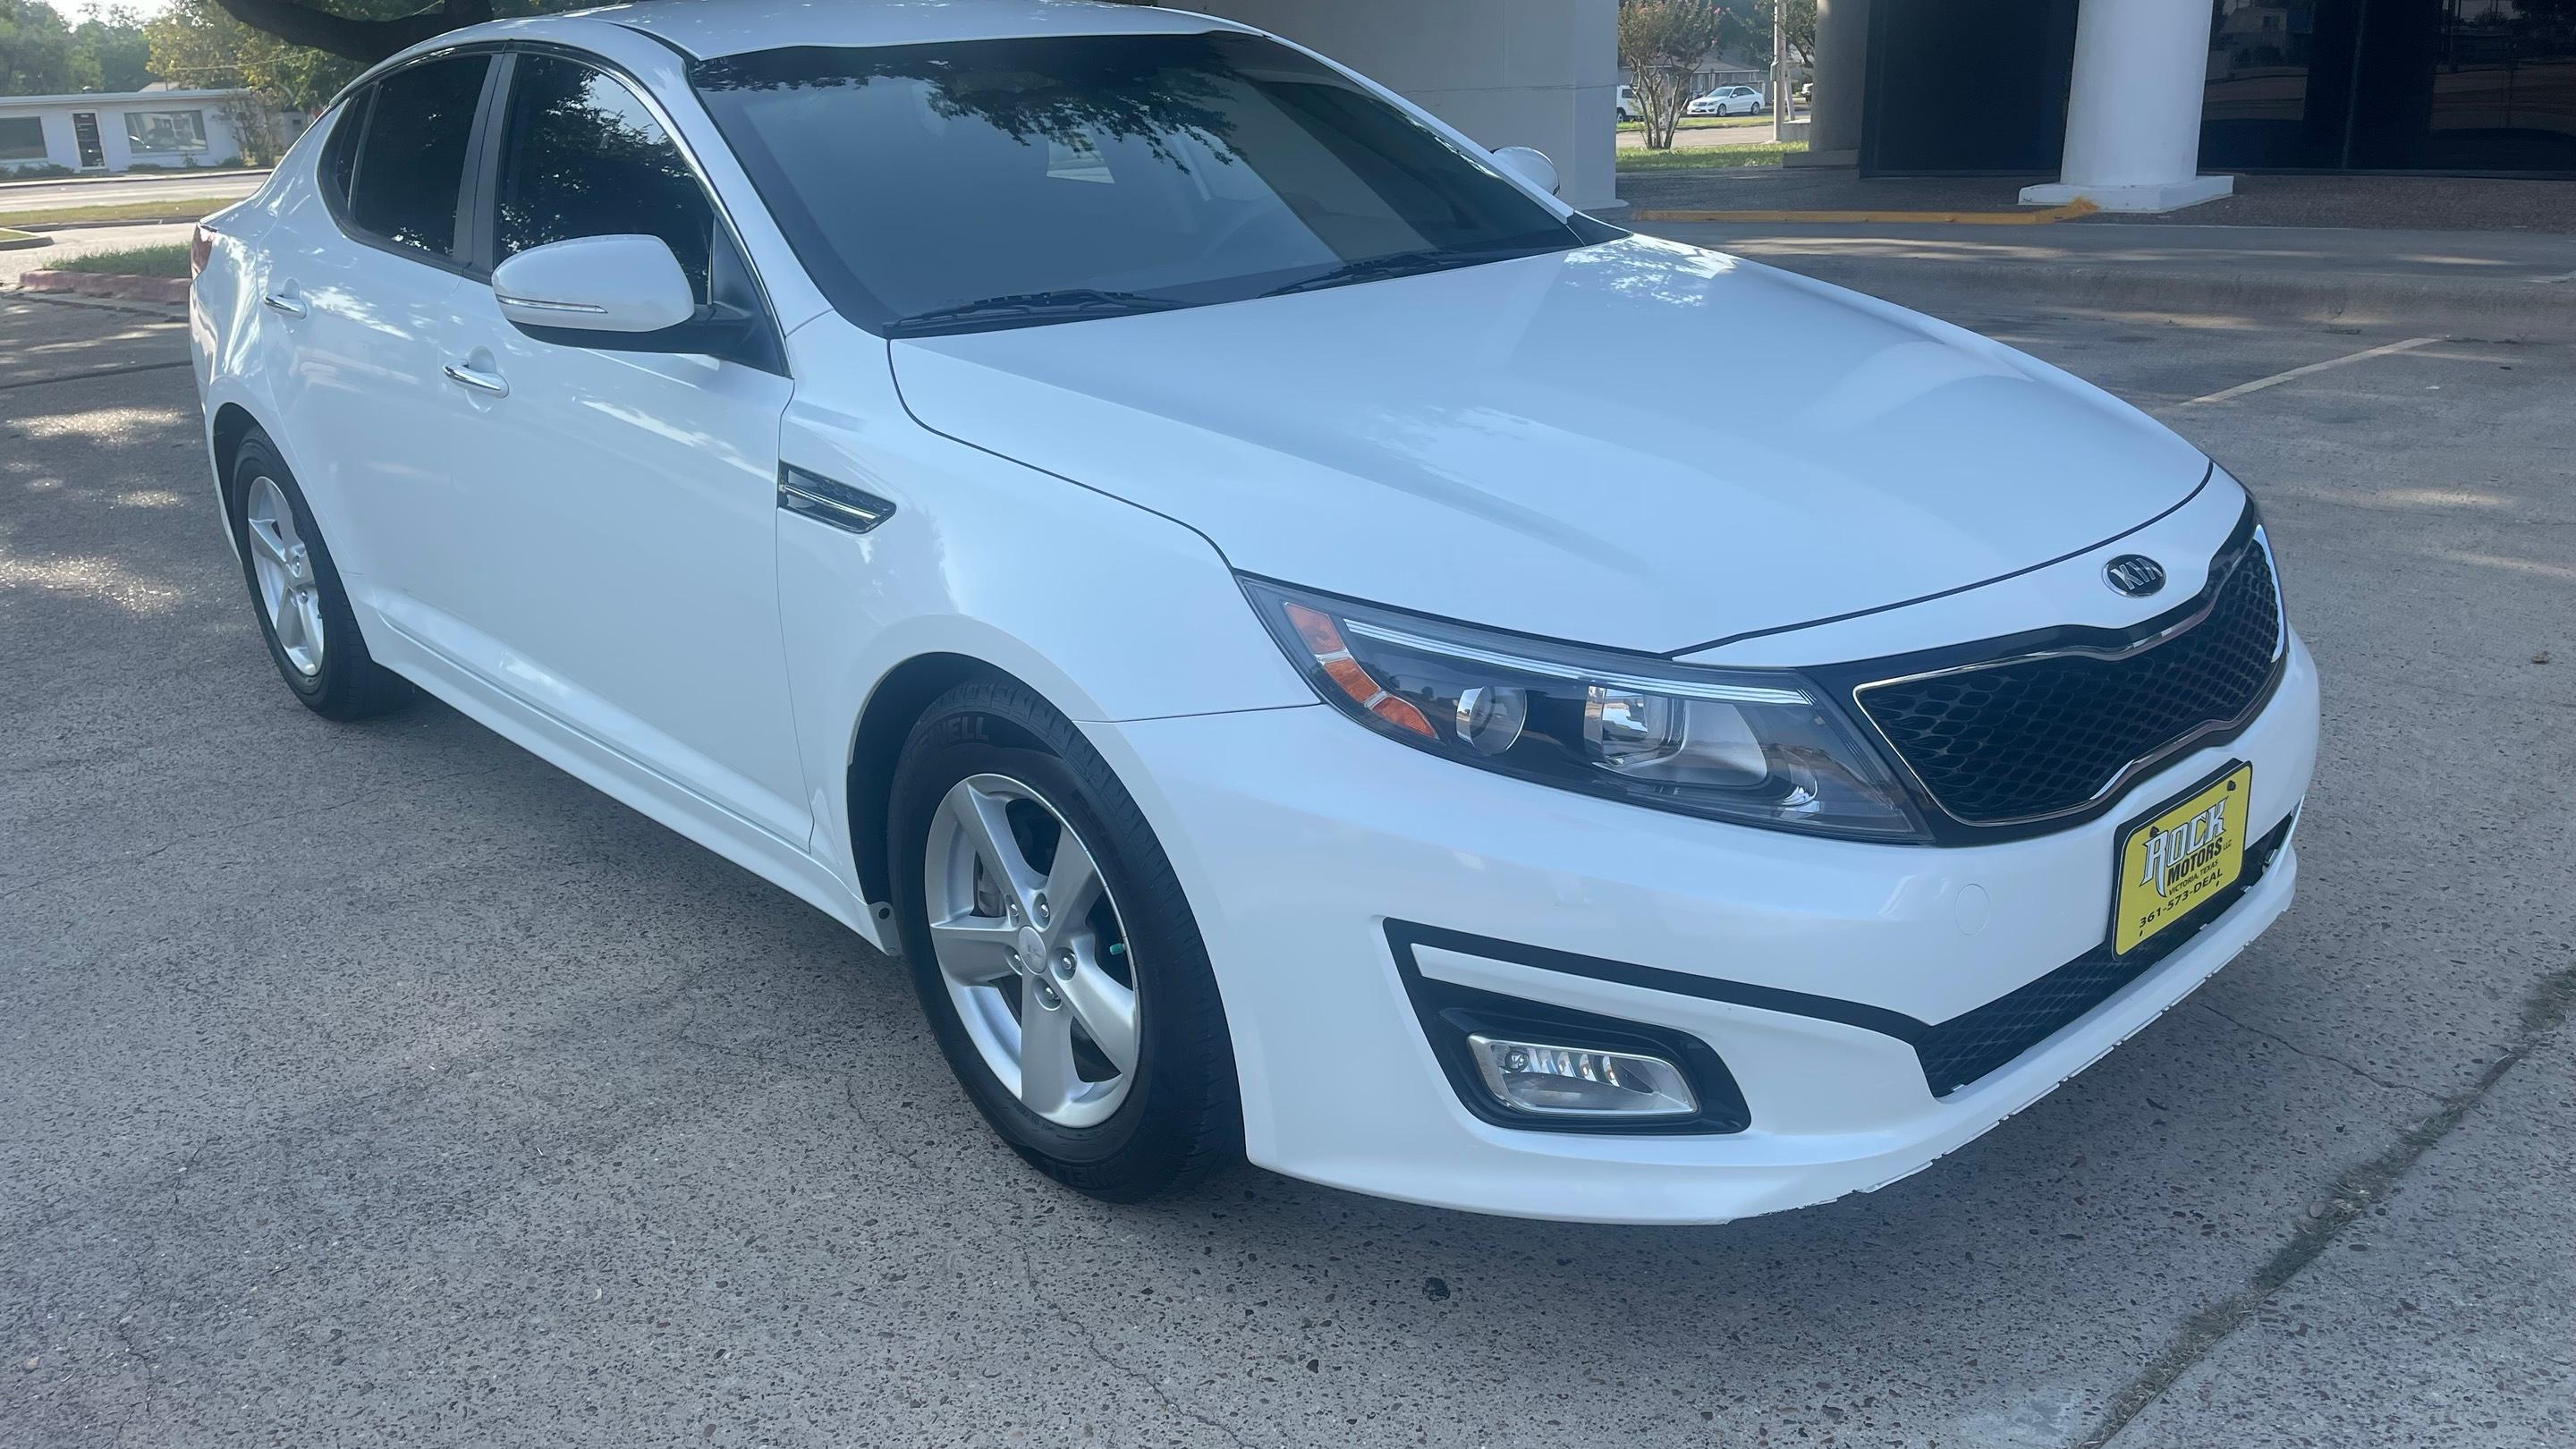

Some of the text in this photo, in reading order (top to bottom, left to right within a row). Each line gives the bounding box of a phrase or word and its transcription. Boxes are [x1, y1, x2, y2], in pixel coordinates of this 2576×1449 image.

[2110, 557, 2163, 590] KIA
[2140, 796, 2229, 897] ROCK
[2167, 837, 2223, 886] MOTORS
[2200, 860, 2219, 876] TEXAS
[2140, 869, 2224, 928] 361-573-DEAL
